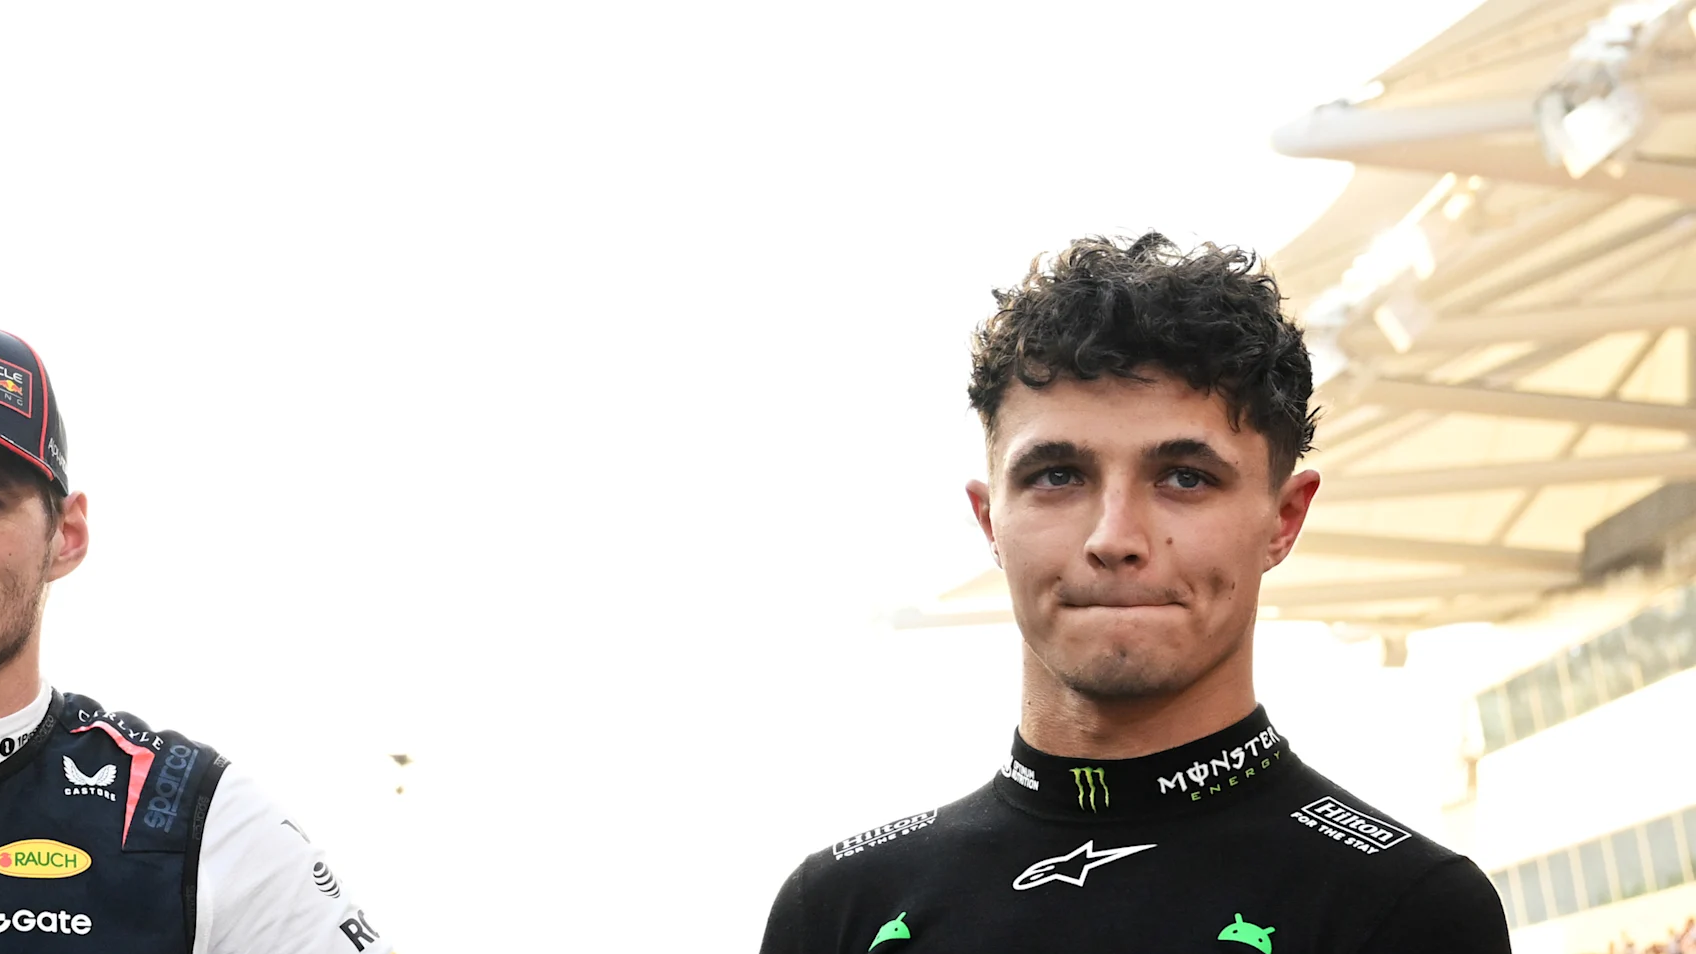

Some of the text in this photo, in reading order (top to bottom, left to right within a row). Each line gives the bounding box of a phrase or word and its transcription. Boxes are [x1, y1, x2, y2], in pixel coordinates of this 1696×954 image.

[144, 744, 196, 831] sparco
[1191, 751, 1281, 801] ENERGY
[64, 787, 117, 801] CASTORE
[1290, 812, 1379, 855] FOR THE STAY
[1314, 802, 1394, 843] Hilton
[15, 851, 77, 868] RAUCH
[835, 846, 865, 861] FOR
[868, 834, 897, 847] THE
[12, 909, 92, 935] Gate
